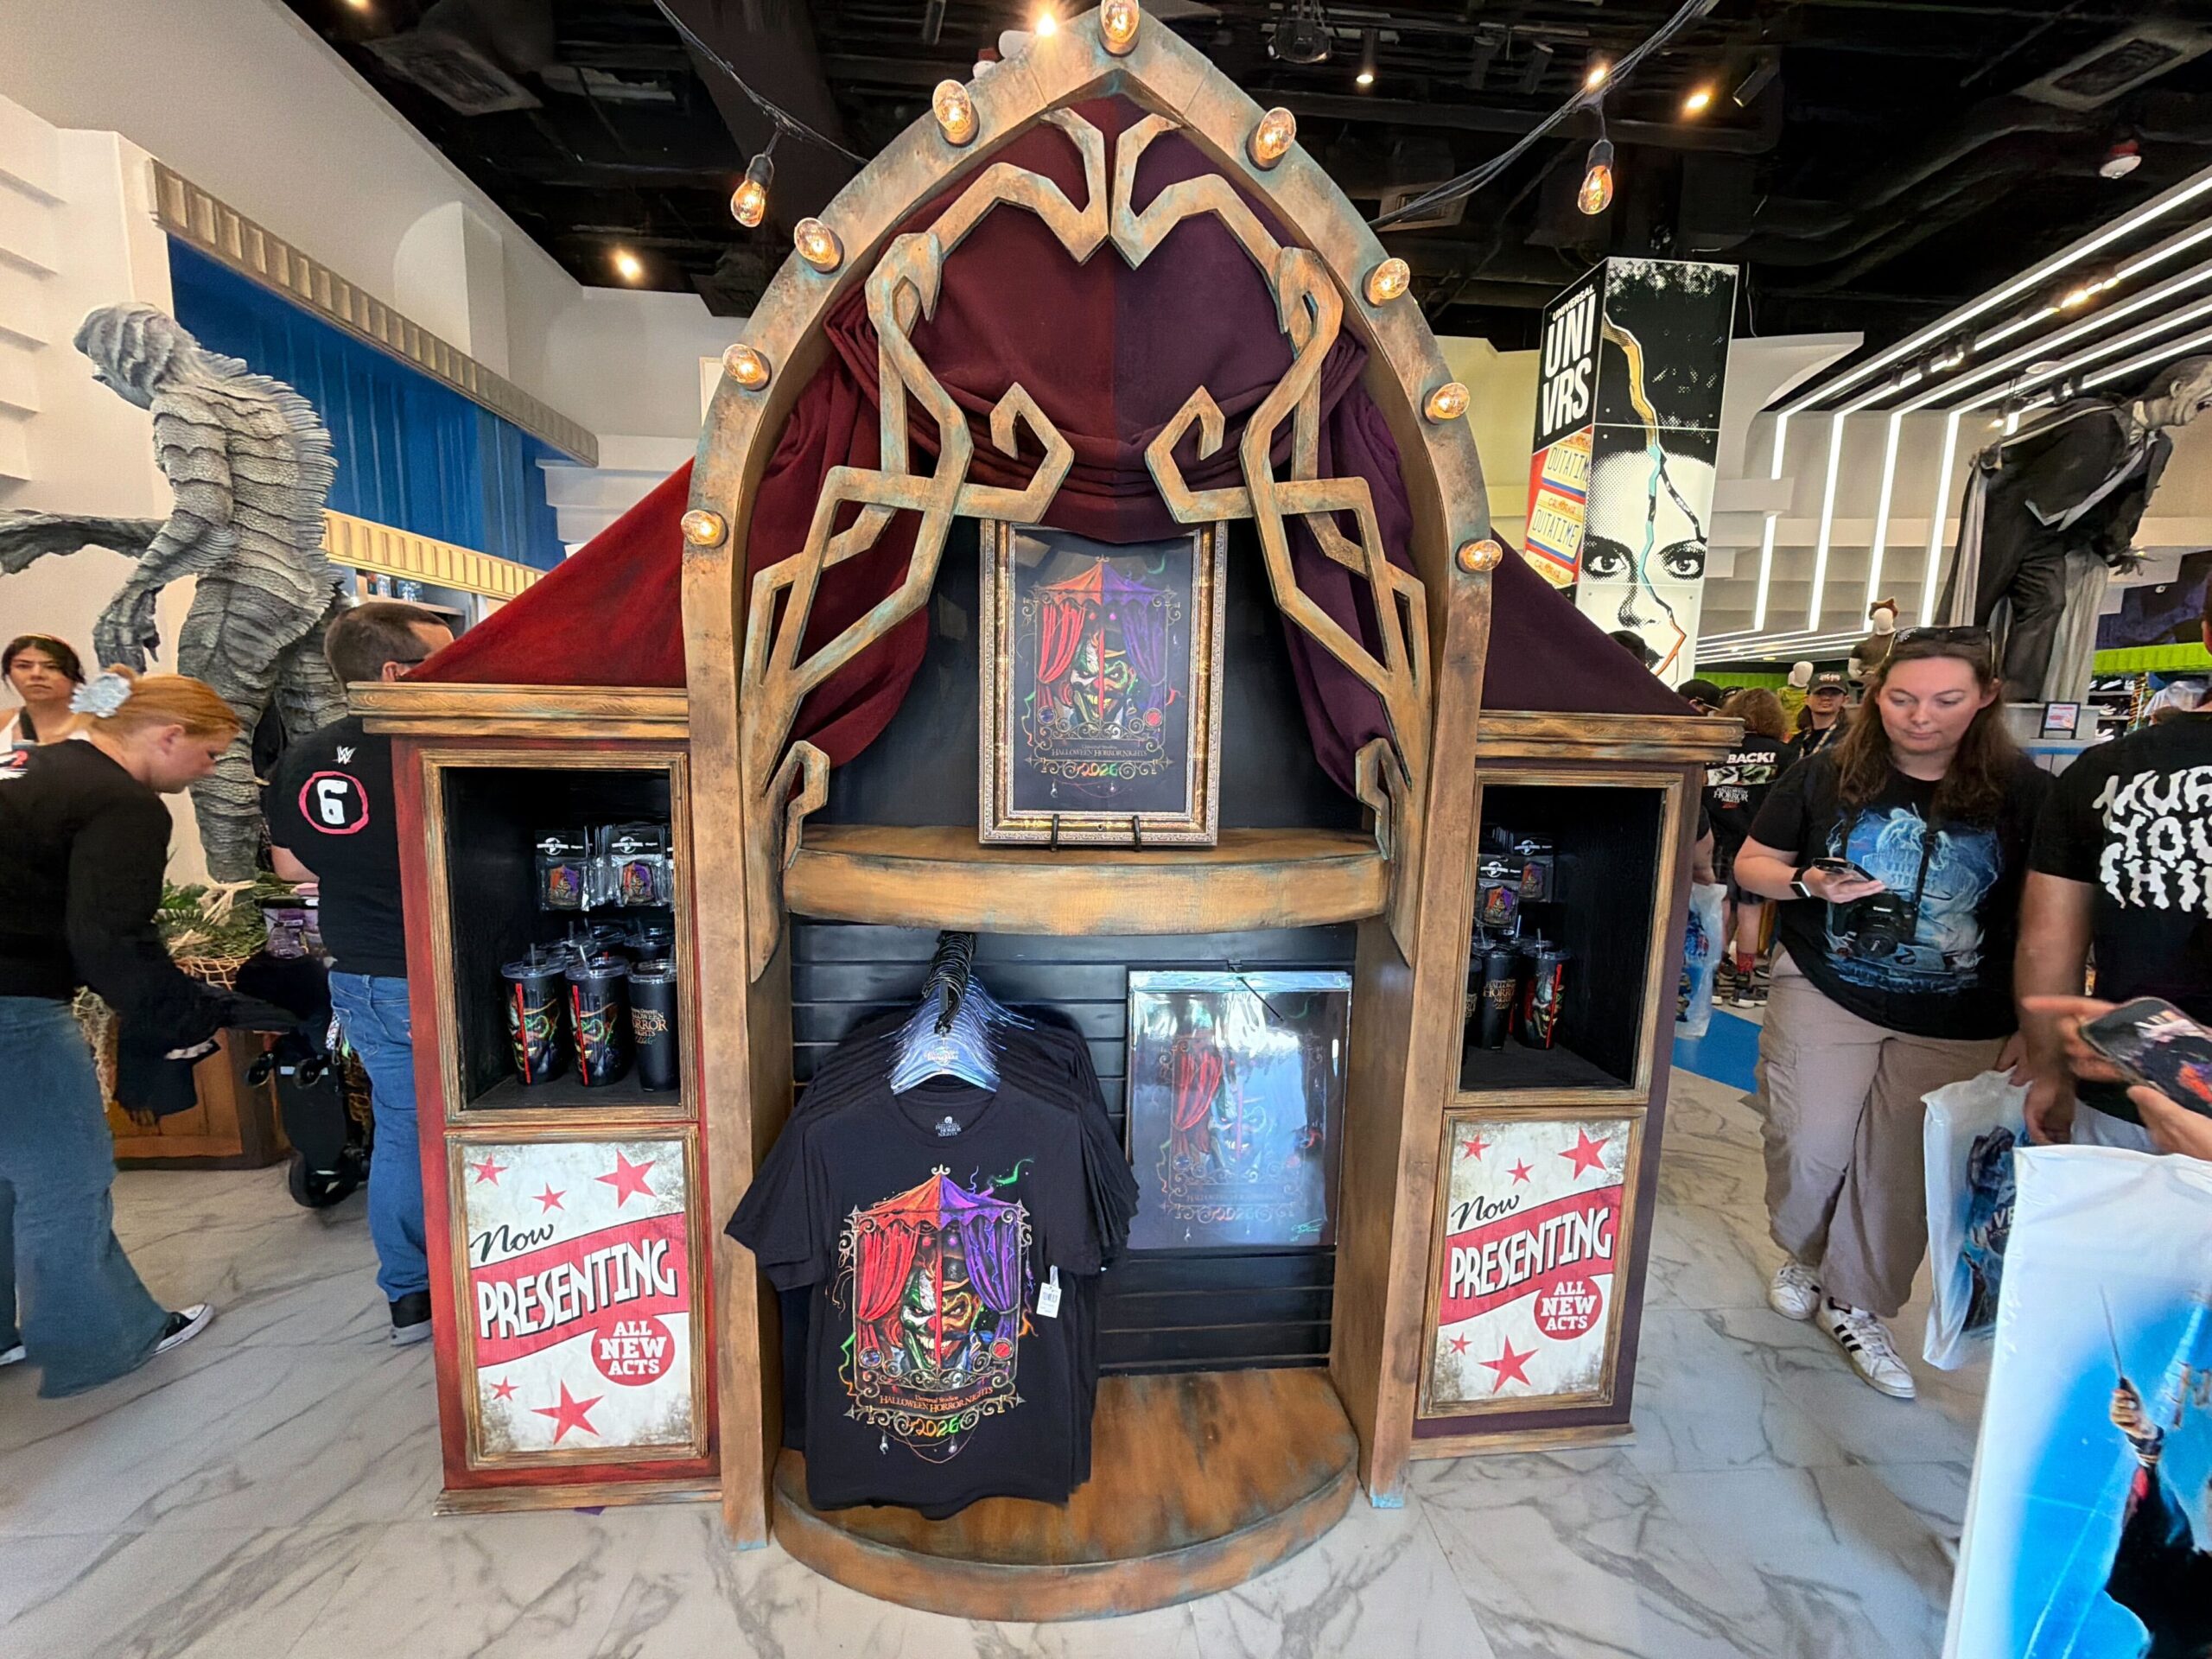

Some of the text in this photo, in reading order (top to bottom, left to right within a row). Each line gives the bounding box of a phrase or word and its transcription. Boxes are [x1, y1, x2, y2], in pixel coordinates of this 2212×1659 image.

[1552, 283, 1596, 321] UNIVERSAL
[1545, 292, 1597, 378] UNI
[1542, 357, 1592, 436] VRS
[1532, 508, 1580, 549] OUTATIME
[1075, 762, 1119, 777] 2026
[1726, 752, 1776, 764] BACK!
[1451, 1194, 1520, 1230] Now
[469, 1224, 555, 1262] Now
[1449, 1207, 1613, 1300] PRESENTING
[477, 1238, 678, 1338] PRESENTING
[1554, 1281, 1586, 1295] ALL
[1540, 1295, 1598, 1317] NEW
[613, 1320, 653, 1337] ALL
[1545, 1315, 1588, 1332] ACTS
[599, 1336, 668, 1360] NEW
[607, 1359, 660, 1376] ACTS
[880, 1386, 994, 1413] HALLOWEEN HORROR NIGHTS
[907, 1414, 961, 1437] 2026
